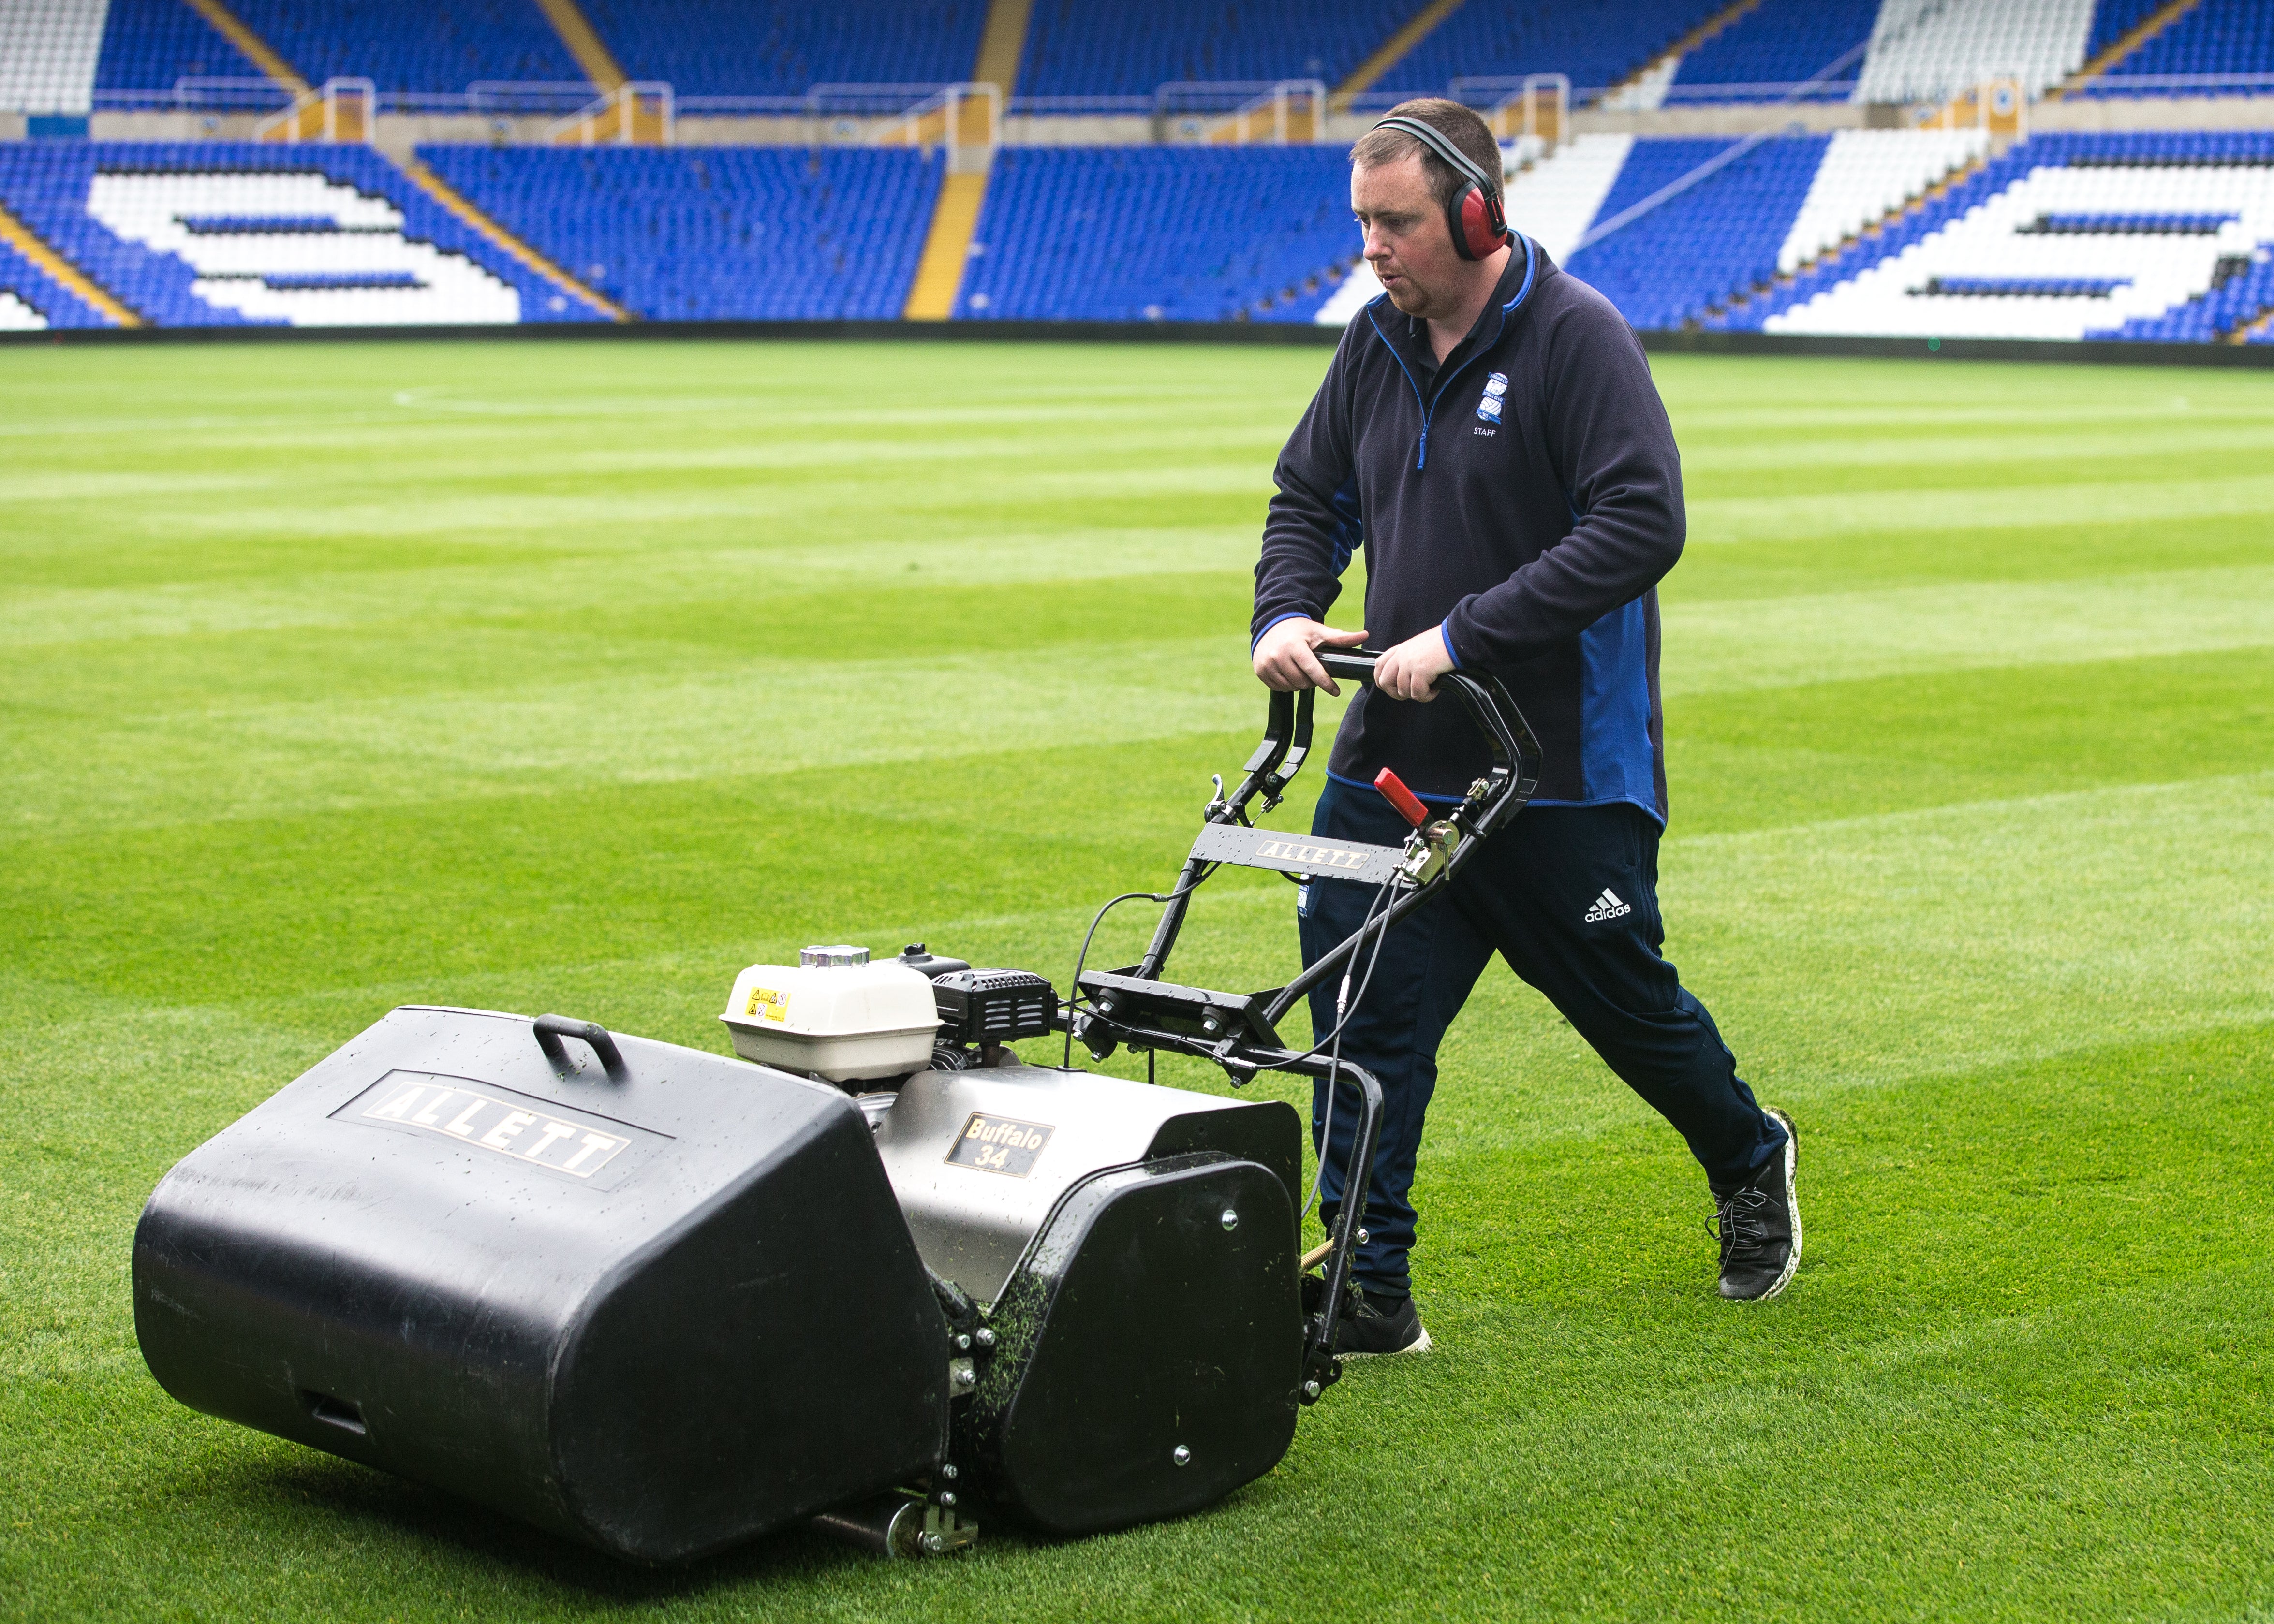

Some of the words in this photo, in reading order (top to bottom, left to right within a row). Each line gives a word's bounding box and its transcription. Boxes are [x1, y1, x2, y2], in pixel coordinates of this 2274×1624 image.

[1473, 427, 1496, 437] STAFF
[1264, 842, 1361, 866] ALLETT
[1585, 904, 1631, 922] adidas
[374, 1086, 617, 1170] ALLETT
[965, 1118, 1043, 1150] Buffalo
[974, 1144, 1010, 1169] 34
